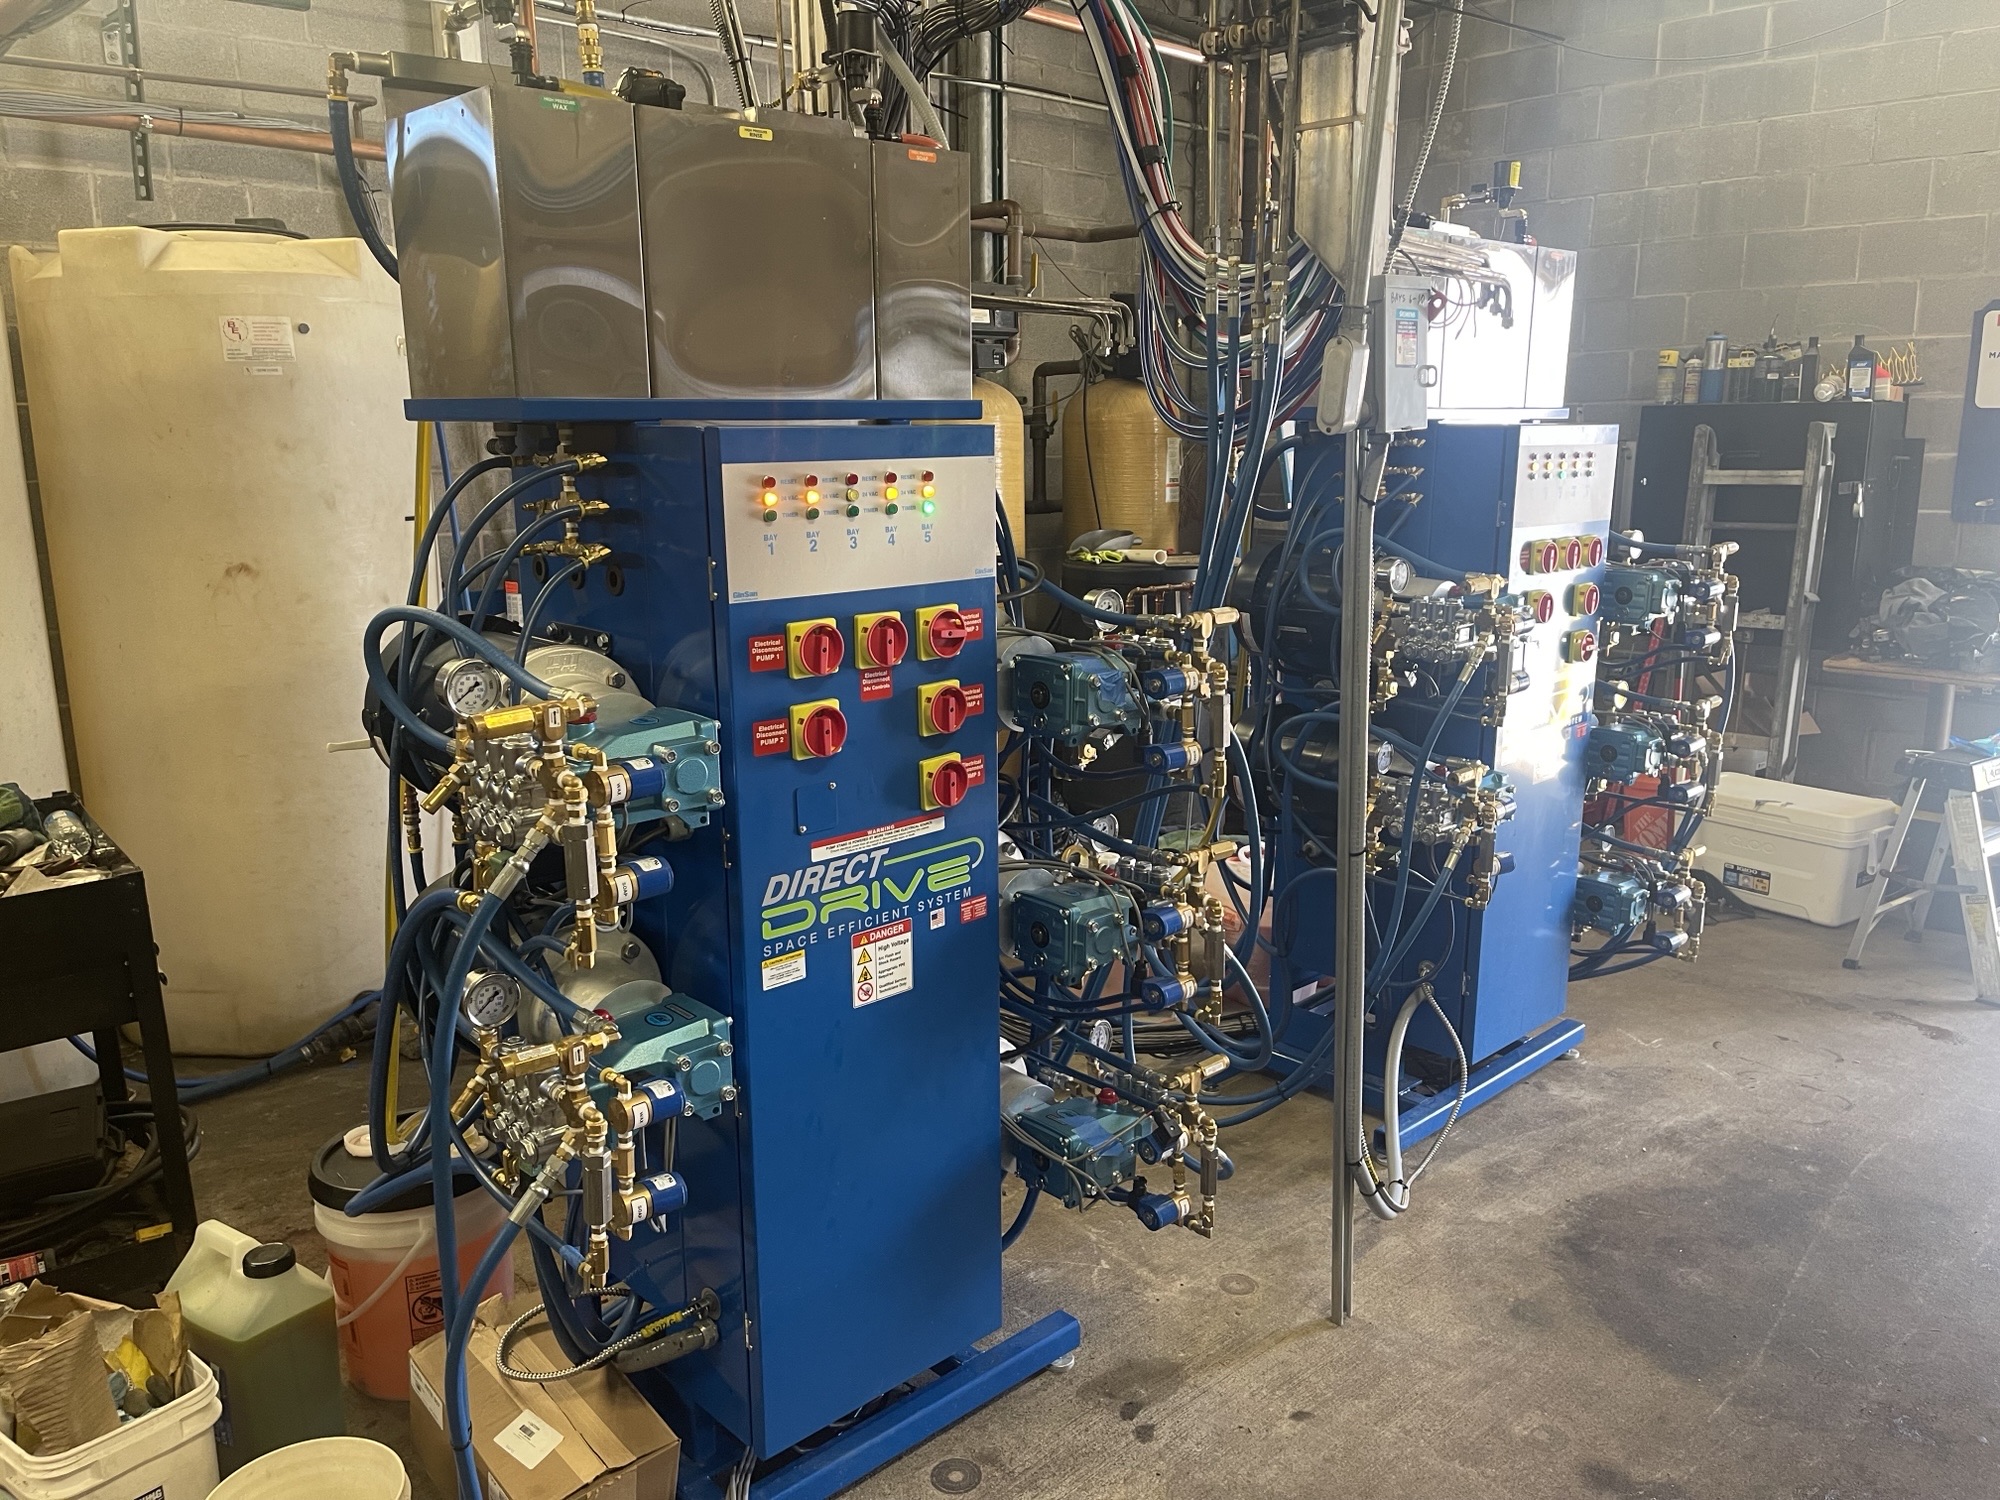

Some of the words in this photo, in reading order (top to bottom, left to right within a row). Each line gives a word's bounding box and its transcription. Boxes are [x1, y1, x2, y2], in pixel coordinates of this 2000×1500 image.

[1391, 292, 1406, 304] BAYS
[846, 528, 860, 536] BAY
[921, 523, 934, 531] BAY
[763, 533, 778, 542] BAY
[806, 531, 820, 539] BAY
[887, 533, 896, 546] 4
[924, 531, 932, 543] 5
[768, 543, 775, 555] 1
[809, 539, 818, 552] 2
[849, 537, 858, 550] 3
[733, 591, 758, 599] GinSan
[754, 639, 781, 648] Electrical
[751, 645, 784, 654] Disconnect
[756, 654, 775, 662] PUMP
[862, 675, 890, 685] Disconnect
[864, 670, 888, 679] Electrical
[871, 683, 890, 691] Controls
[758, 722, 785, 732] Electrical
[756, 728, 788, 739] Disconnect
[760, 737, 779, 746] PUMP
[1633, 811, 1655, 833] THE
[867, 824, 895, 835] WARNING
[762, 848, 890, 907] DIRECT
[762, 855, 971, 941] DRIVE
[763, 932, 818, 957] SPACE
[827, 905, 910, 939] EFFICIENT
[918, 886, 972, 912] SYSTEM
[869, 923, 904, 942] DANGER
[878, 944, 891, 952] High
[890, 938, 909, 948] Voltage
